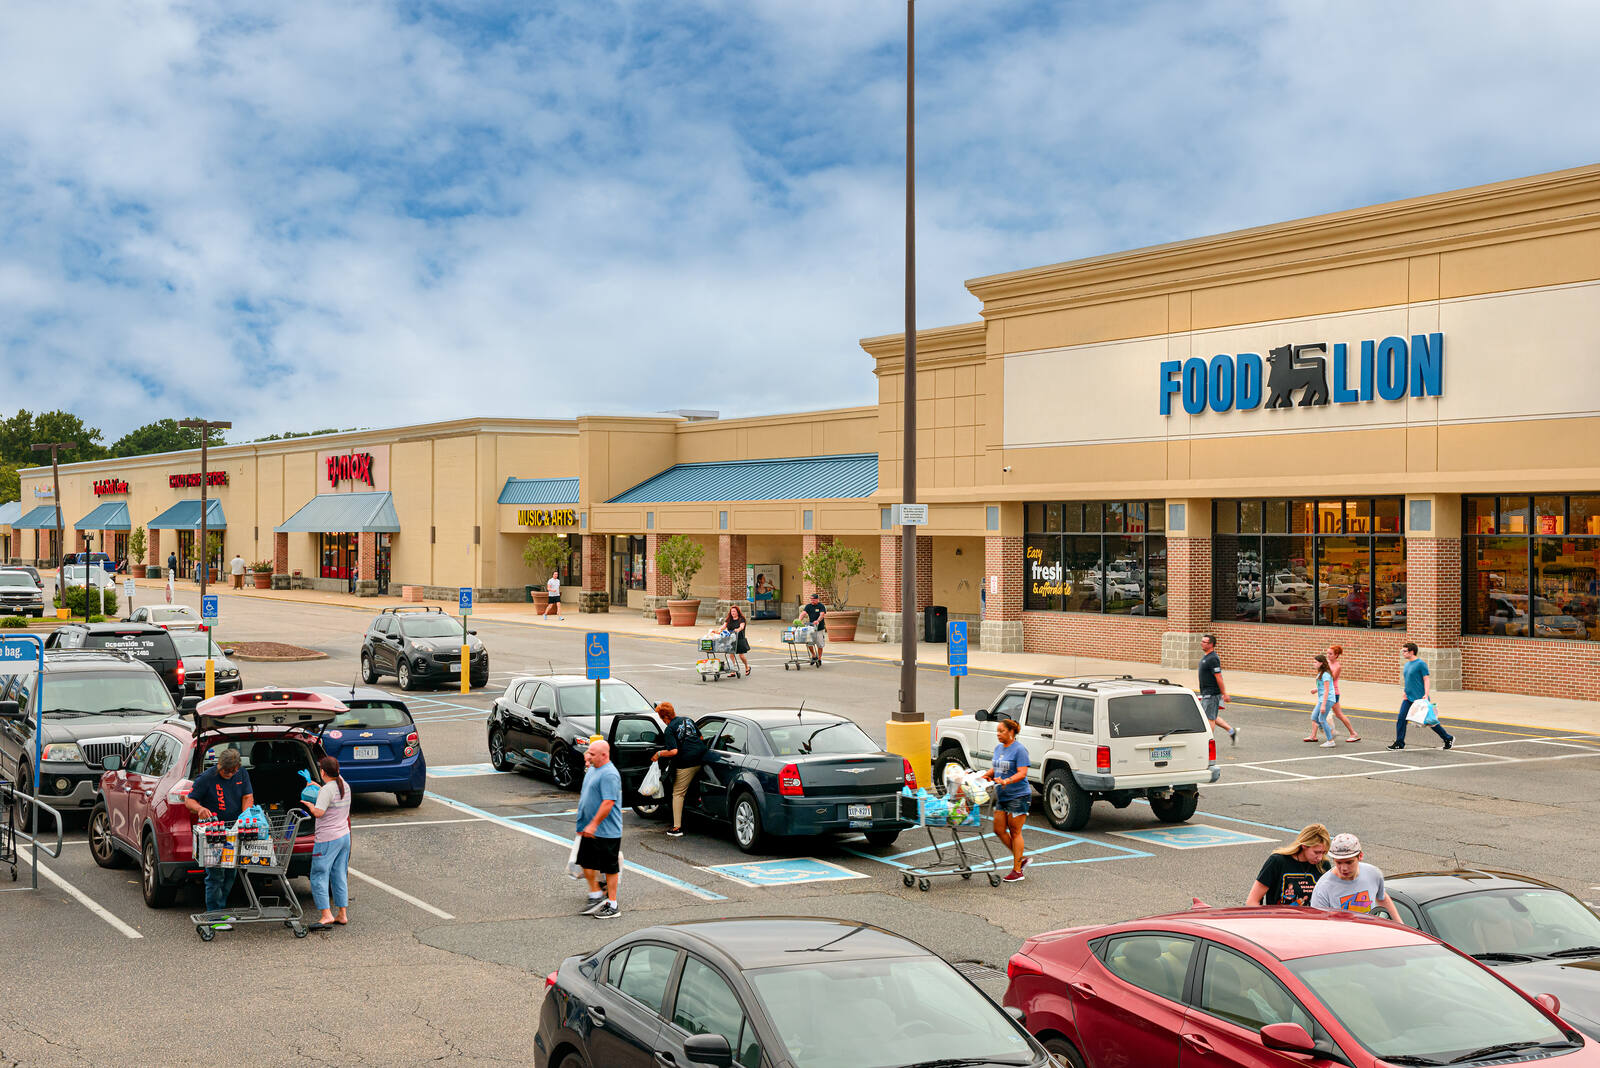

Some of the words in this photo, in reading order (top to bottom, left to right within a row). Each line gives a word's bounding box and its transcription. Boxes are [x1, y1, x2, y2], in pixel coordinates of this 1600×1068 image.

[1160, 352, 1263, 416] FOOD
[1333, 332, 1445, 403] LION
[518, 509, 543, 526] MUSIC
[543, 510, 551, 526] &
[551, 508, 574, 526] ARTS
[1324, 511, 1366, 533] Dairy
[1027, 546, 1043, 565] Easy
[1032, 560, 1063, 580] fresh
[1033, 582, 1039, 594] &
[5, 645, 23, 658] bag.
